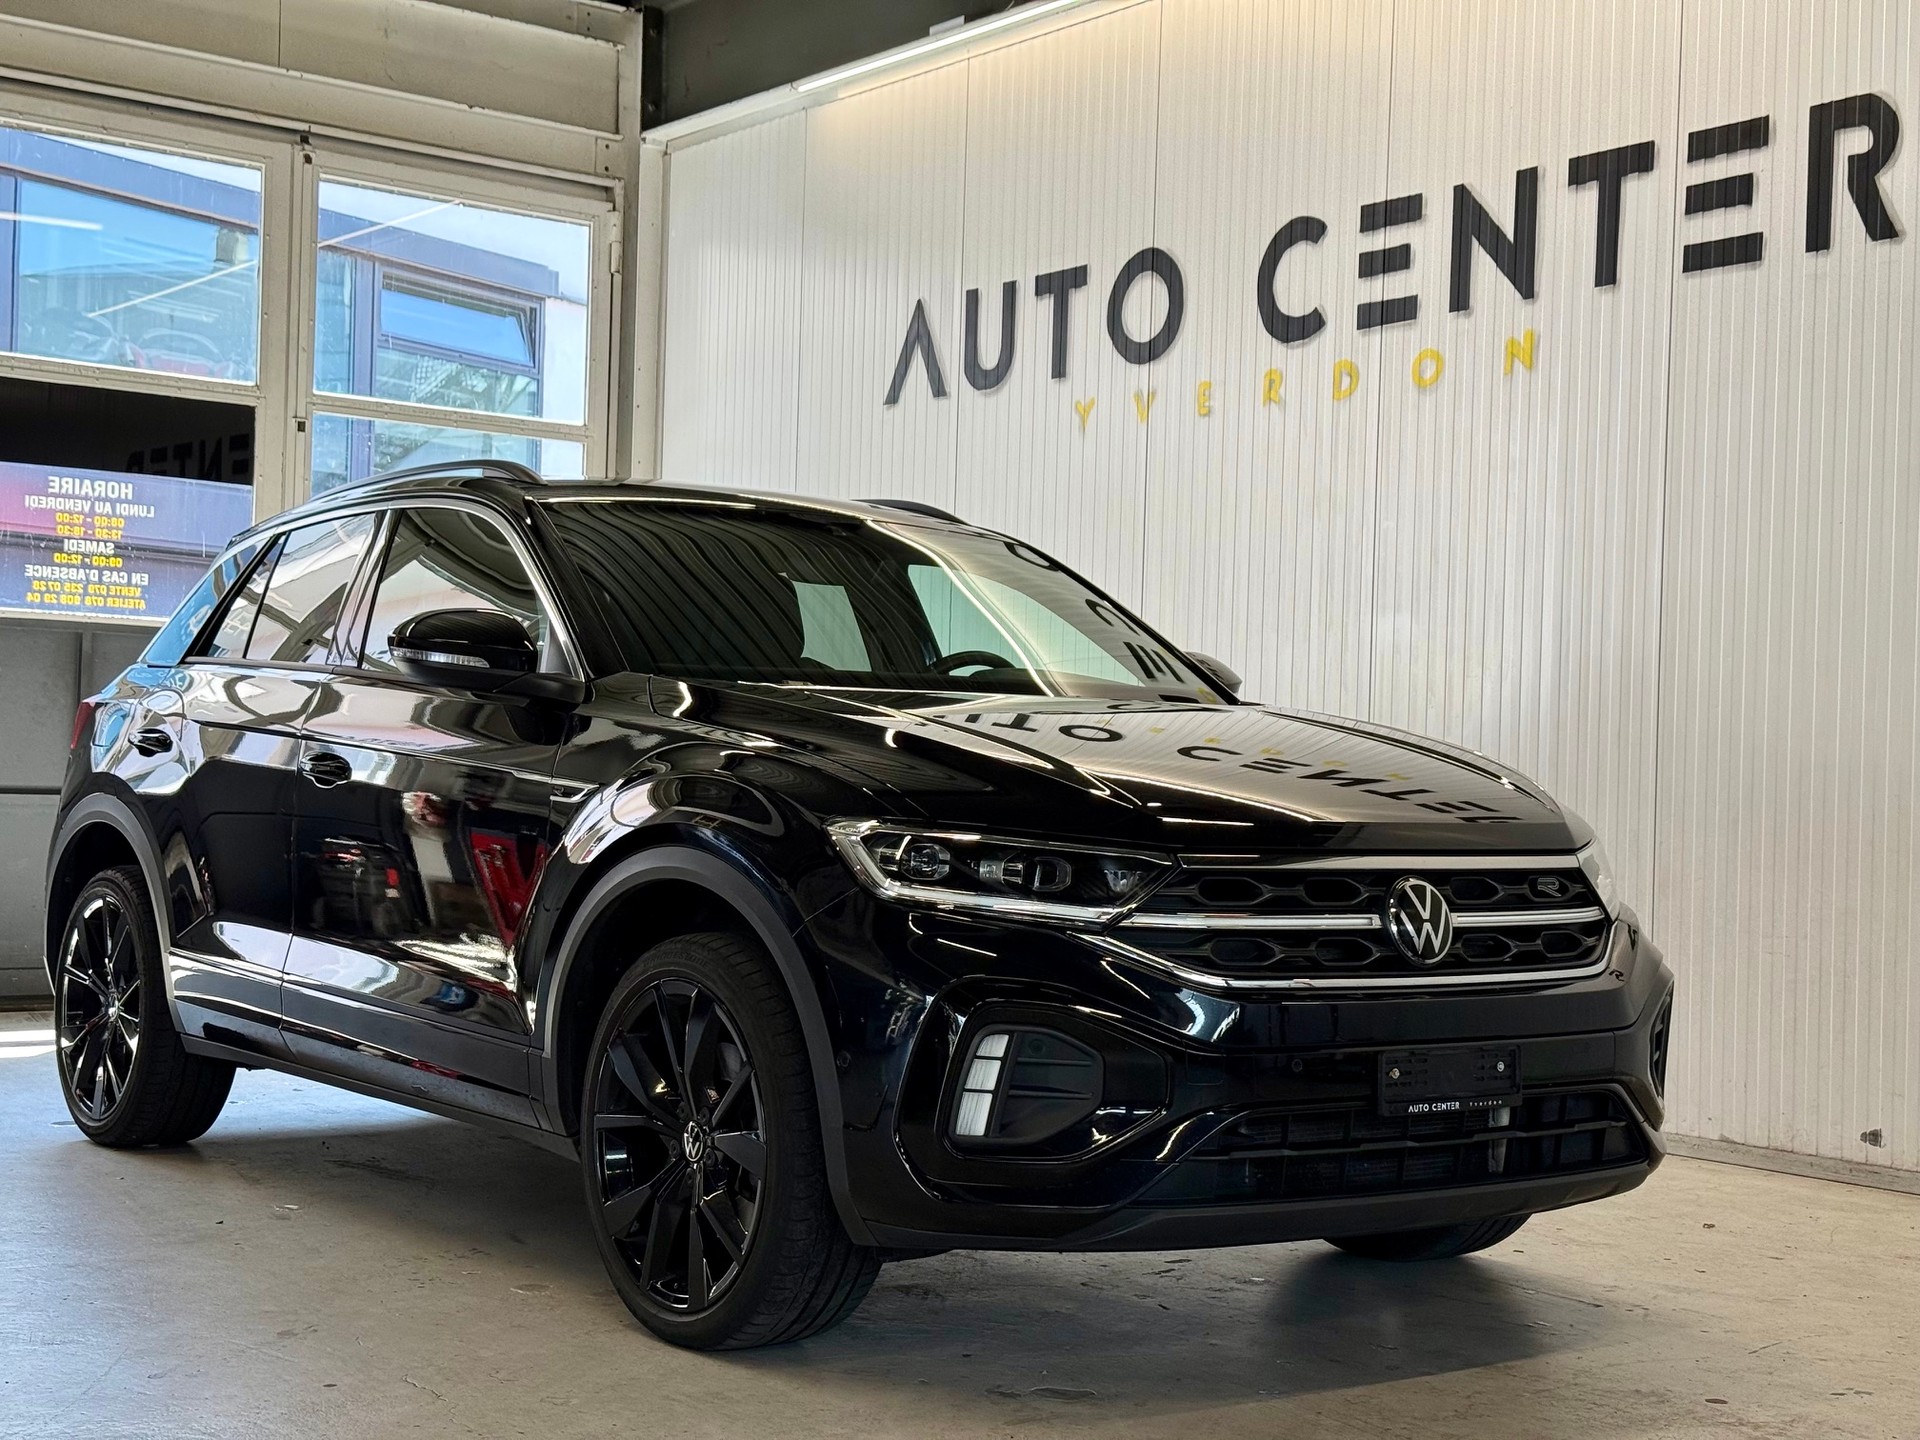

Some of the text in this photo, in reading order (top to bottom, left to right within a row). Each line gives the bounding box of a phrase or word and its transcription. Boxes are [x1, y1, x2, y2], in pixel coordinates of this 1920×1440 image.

[883, 92, 1901, 406] AUTO CENTER
[1075, 328, 1537, 433] YVERDON
[1389, 877, 1453, 965] VW
[1536, 877, 1562, 897] R
[1408, 1103, 1430, 1113] AUTO
[1431, 1101, 1460, 1111] CENTER
